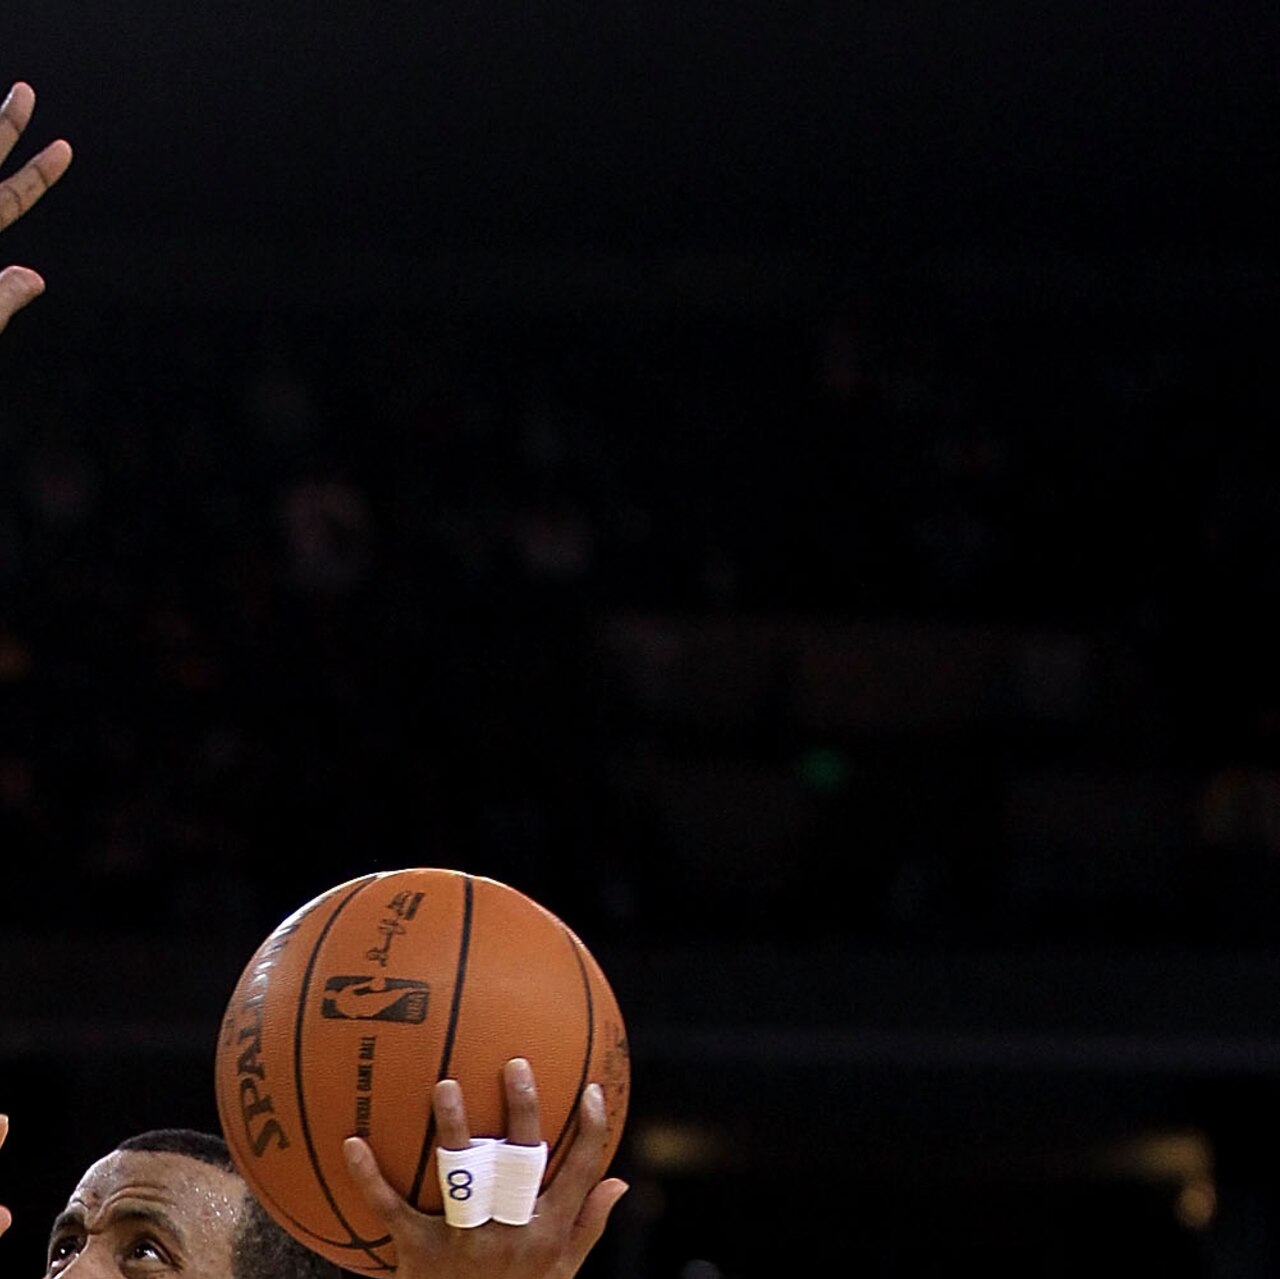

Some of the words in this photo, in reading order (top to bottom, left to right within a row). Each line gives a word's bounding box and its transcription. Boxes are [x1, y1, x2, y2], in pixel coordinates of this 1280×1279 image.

[359, 1036, 376, 1060] BALL
[357, 1064, 373, 1091] GAME
[446, 1169, 474, 1201] 8
